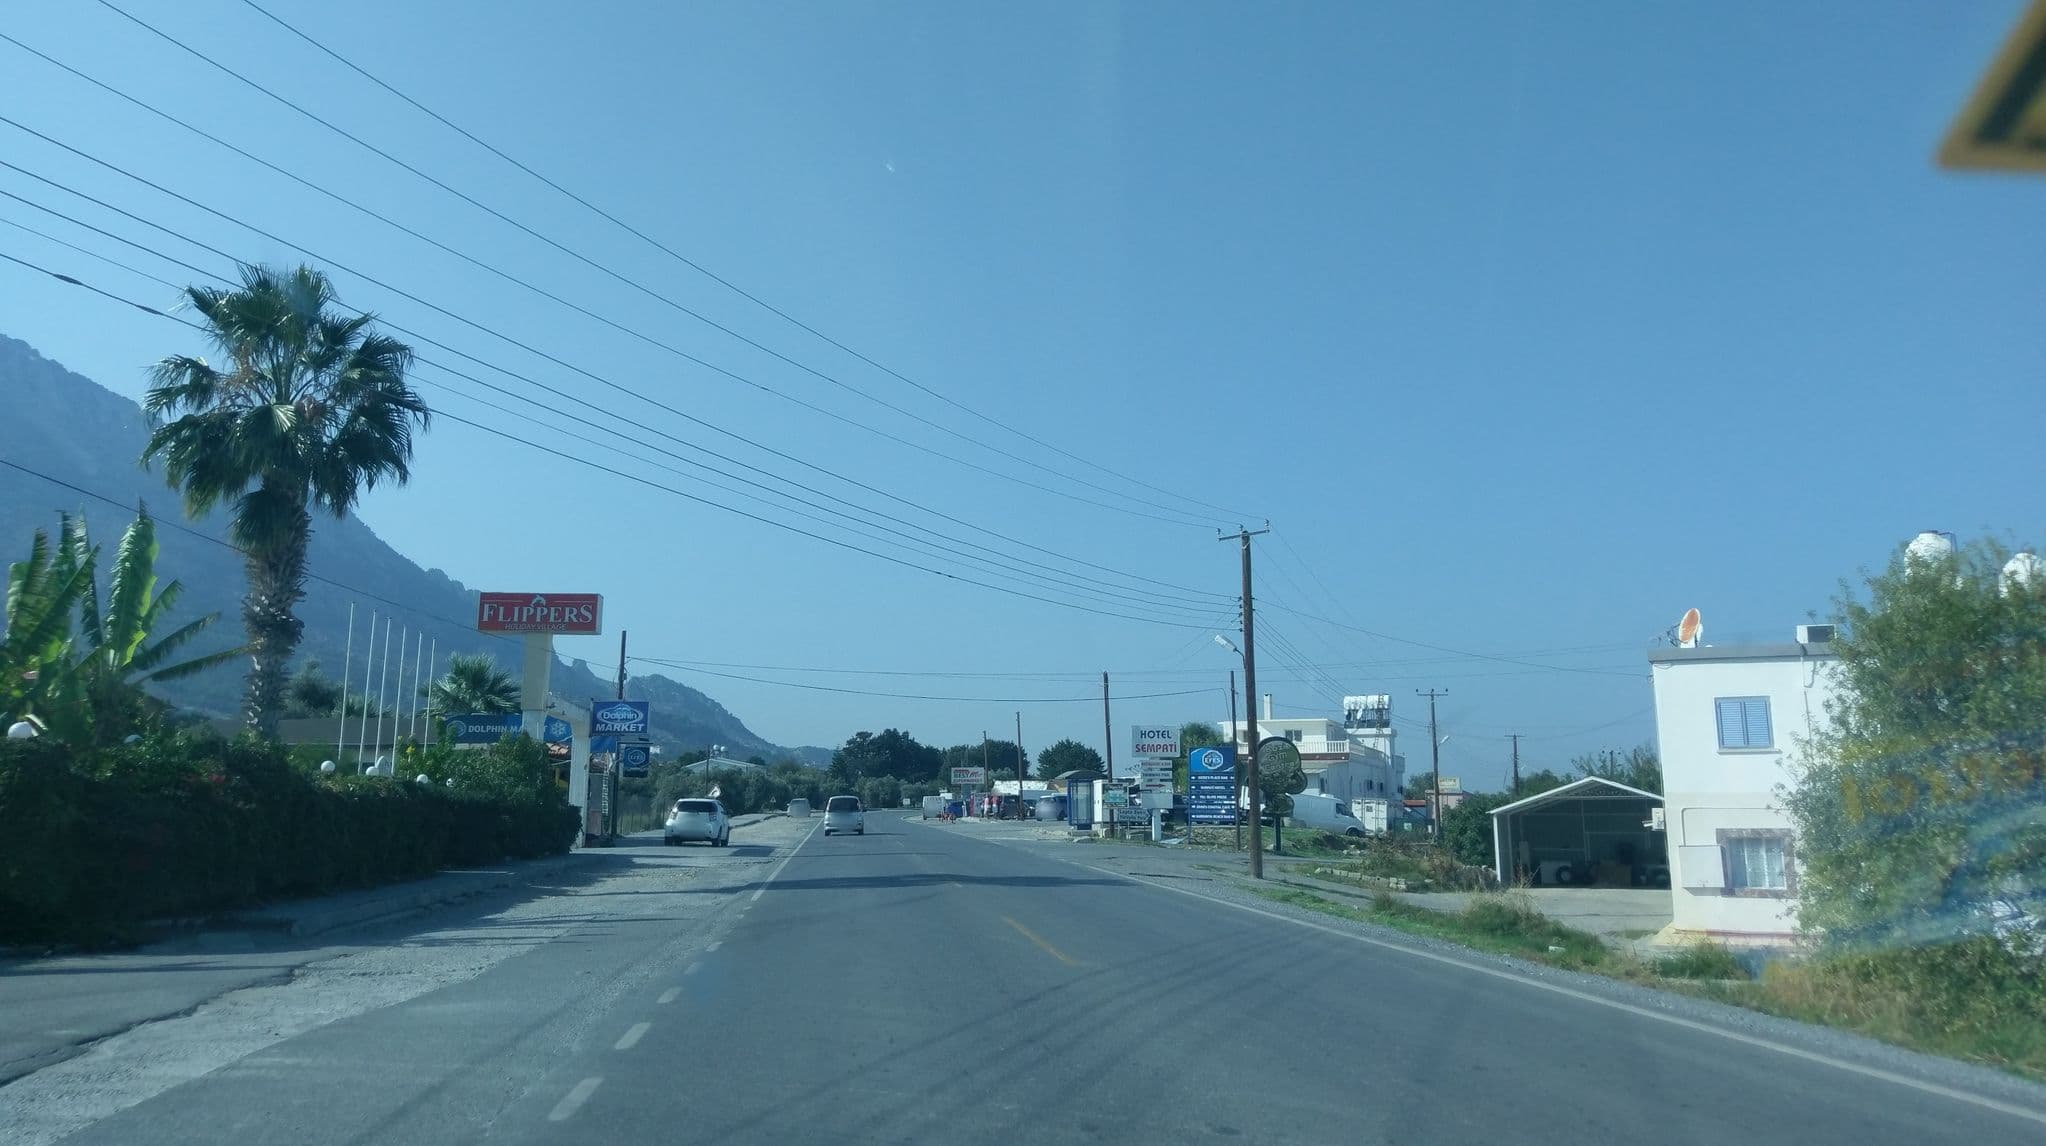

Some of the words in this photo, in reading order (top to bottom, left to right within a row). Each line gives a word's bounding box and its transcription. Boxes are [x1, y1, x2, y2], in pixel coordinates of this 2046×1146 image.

[482, 603, 593, 623] FLIPPERS
[603, 711, 637, 721] Dolphin
[468, 724, 507, 733] DOLPHIN
[595, 723, 645, 732] MARKET
[1140, 730, 1172, 739] HOTEL
